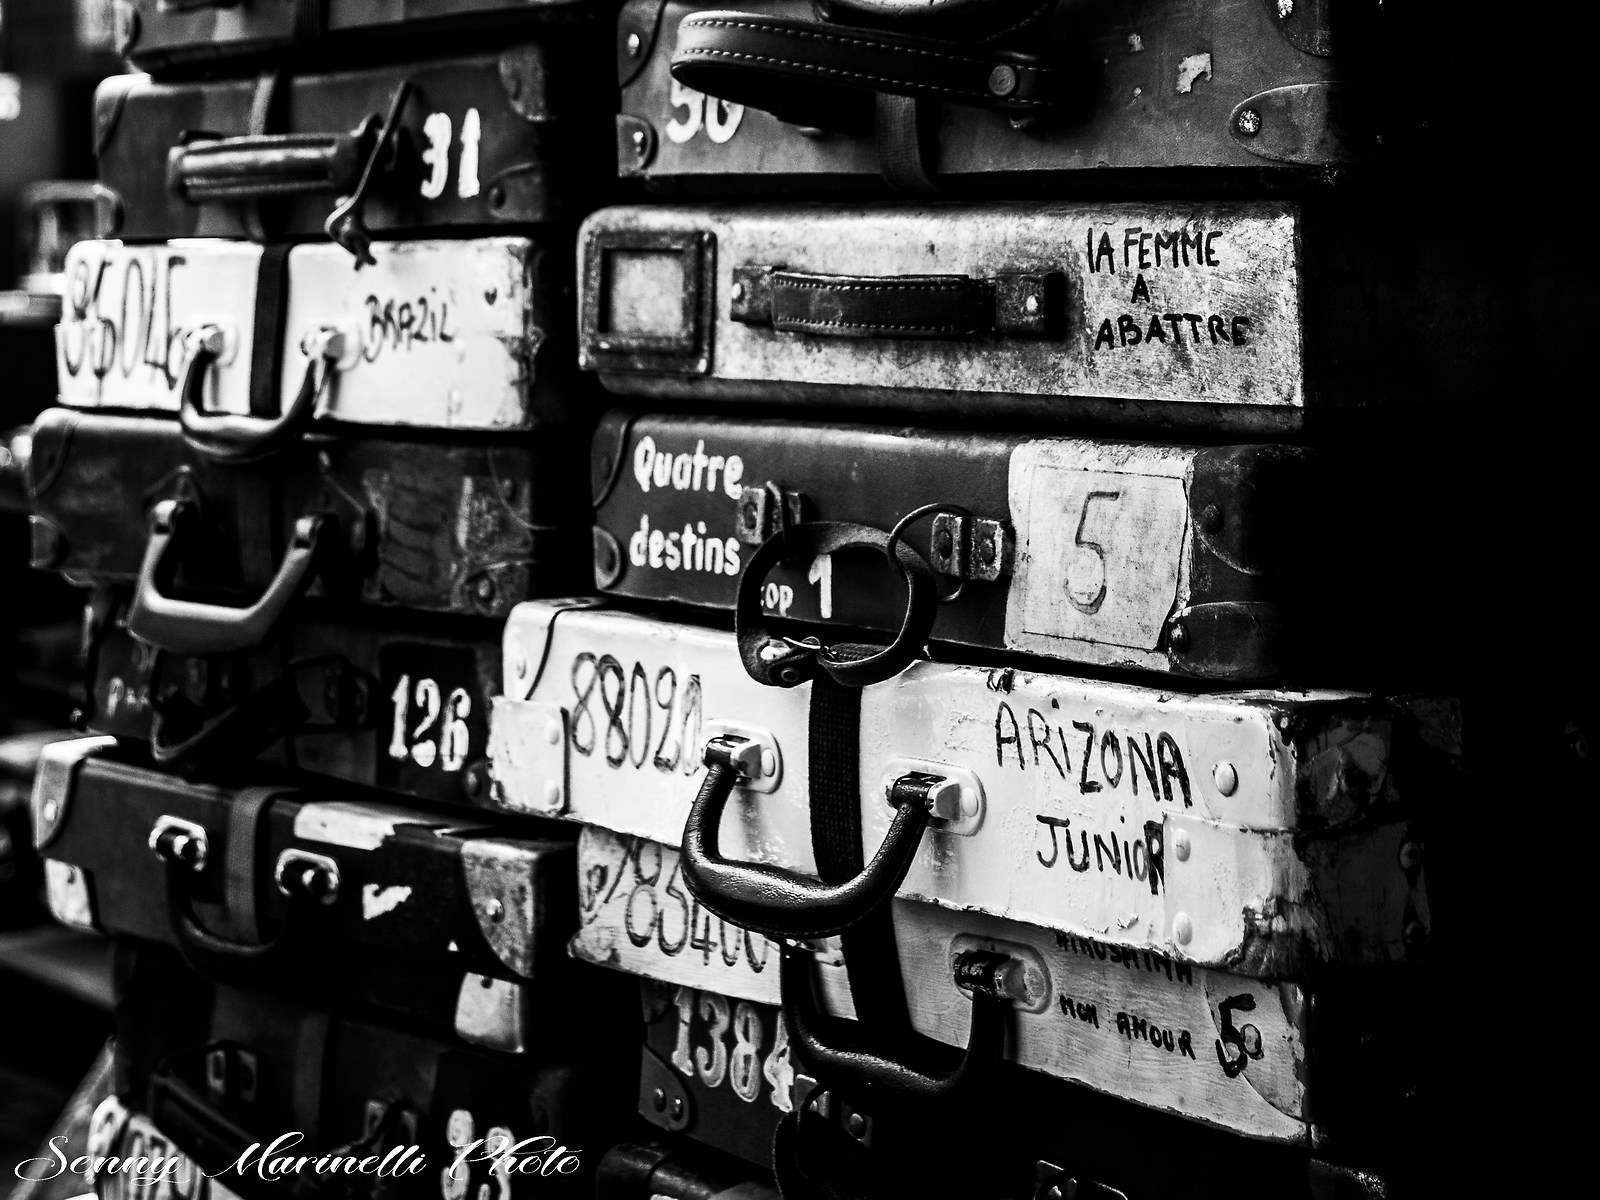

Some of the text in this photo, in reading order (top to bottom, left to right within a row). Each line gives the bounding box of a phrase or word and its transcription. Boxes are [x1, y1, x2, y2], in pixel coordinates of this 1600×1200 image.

[420, 107, 482, 200] 31
[1124, 227, 1223, 269] FEMME
[1131, 274, 1150, 304] A
[1095, 313, 1250, 351] ABATTRE
[634, 435, 744, 500] Quatre
[630, 513, 740, 577] destins
[1063, 491, 1120, 615] 5
[808, 554, 832, 619] 1
[1116, 1012, 1197, 1061] AMOUR
